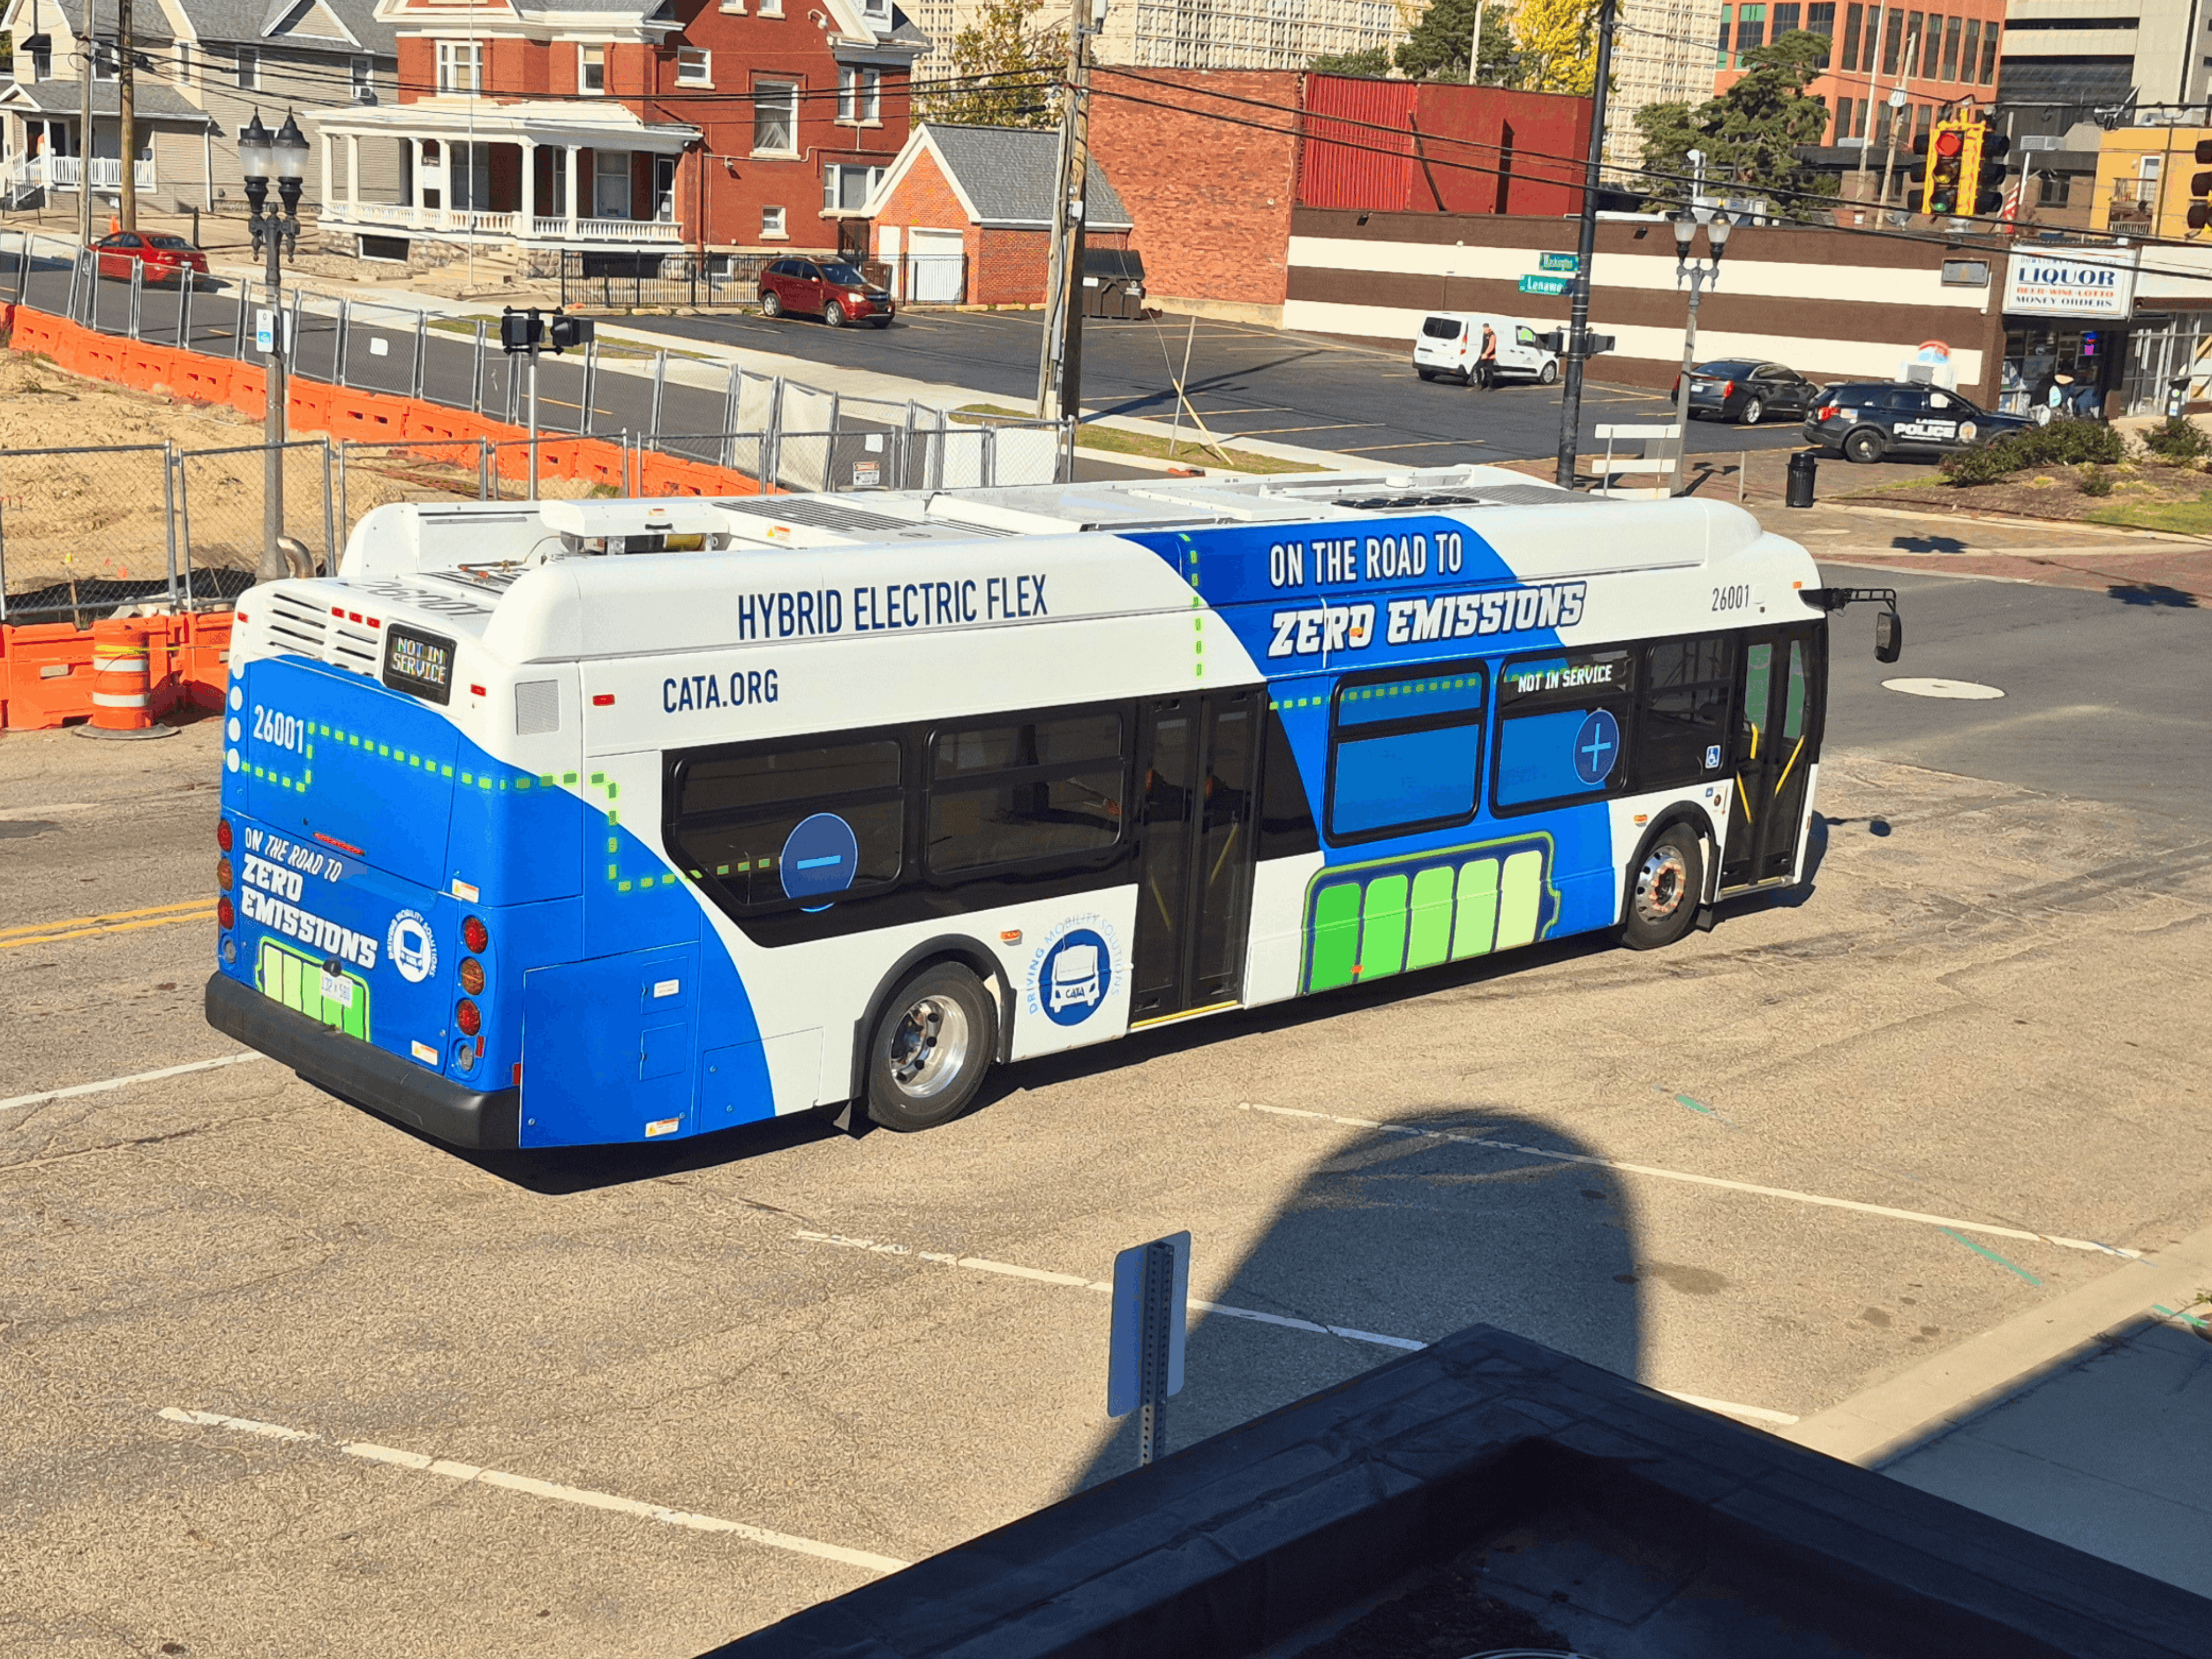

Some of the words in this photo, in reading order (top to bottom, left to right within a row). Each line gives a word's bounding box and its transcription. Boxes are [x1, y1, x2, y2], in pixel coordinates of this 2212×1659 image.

[1527, 276, 1563, 293] Lenawe
[2019, 268, 2115, 285] LIQUOR
[2016, 296, 2056, 305] MONEY
[2061, 298, 2112, 307] ORDERS
[1893, 423, 1955, 438] POLICE
[1271, 545, 1303, 586] ON
[1312, 540, 1357, 583] THE
[1366, 535, 1427, 579] ROAD
[1436, 533, 1462, 573] TO
[738, 589, 842, 640] HYBRID
[854, 580, 977, 631] ELECTRIC
[987, 574, 1048, 619] FLEX
[1712, 584, 1749, 612] 26001
[1268, 604, 1375, 658] ZERO
[1387, 582, 1586, 645] EMISSIONS
[392, 652, 446, 685] SERVICE
[397, 637, 424, 658] NOT
[427, 646, 445, 665] IN
[663, 669, 778, 713] CATA.ORG
[1518, 674, 1541, 692] NOT
[1545, 671, 1559, 690] IN
[1562, 664, 1613, 687] SERVICE
[253, 705, 304, 754] 26001
[245, 827, 263, 852] ON
[265, 834, 290, 862] THE
[288, 844, 324, 875] ROAD
[324, 858, 343, 883] TO
[242, 852, 304, 902] ZERO
[241, 885, 378, 969] EMISSIONS
[1027, 947, 1045, 1015] DRIVING
[1045, 913, 1100, 945] MOBILITY
[1099, 919, 1123, 995] SOLUTIONS
[1066, 987, 1085, 999] CATA
